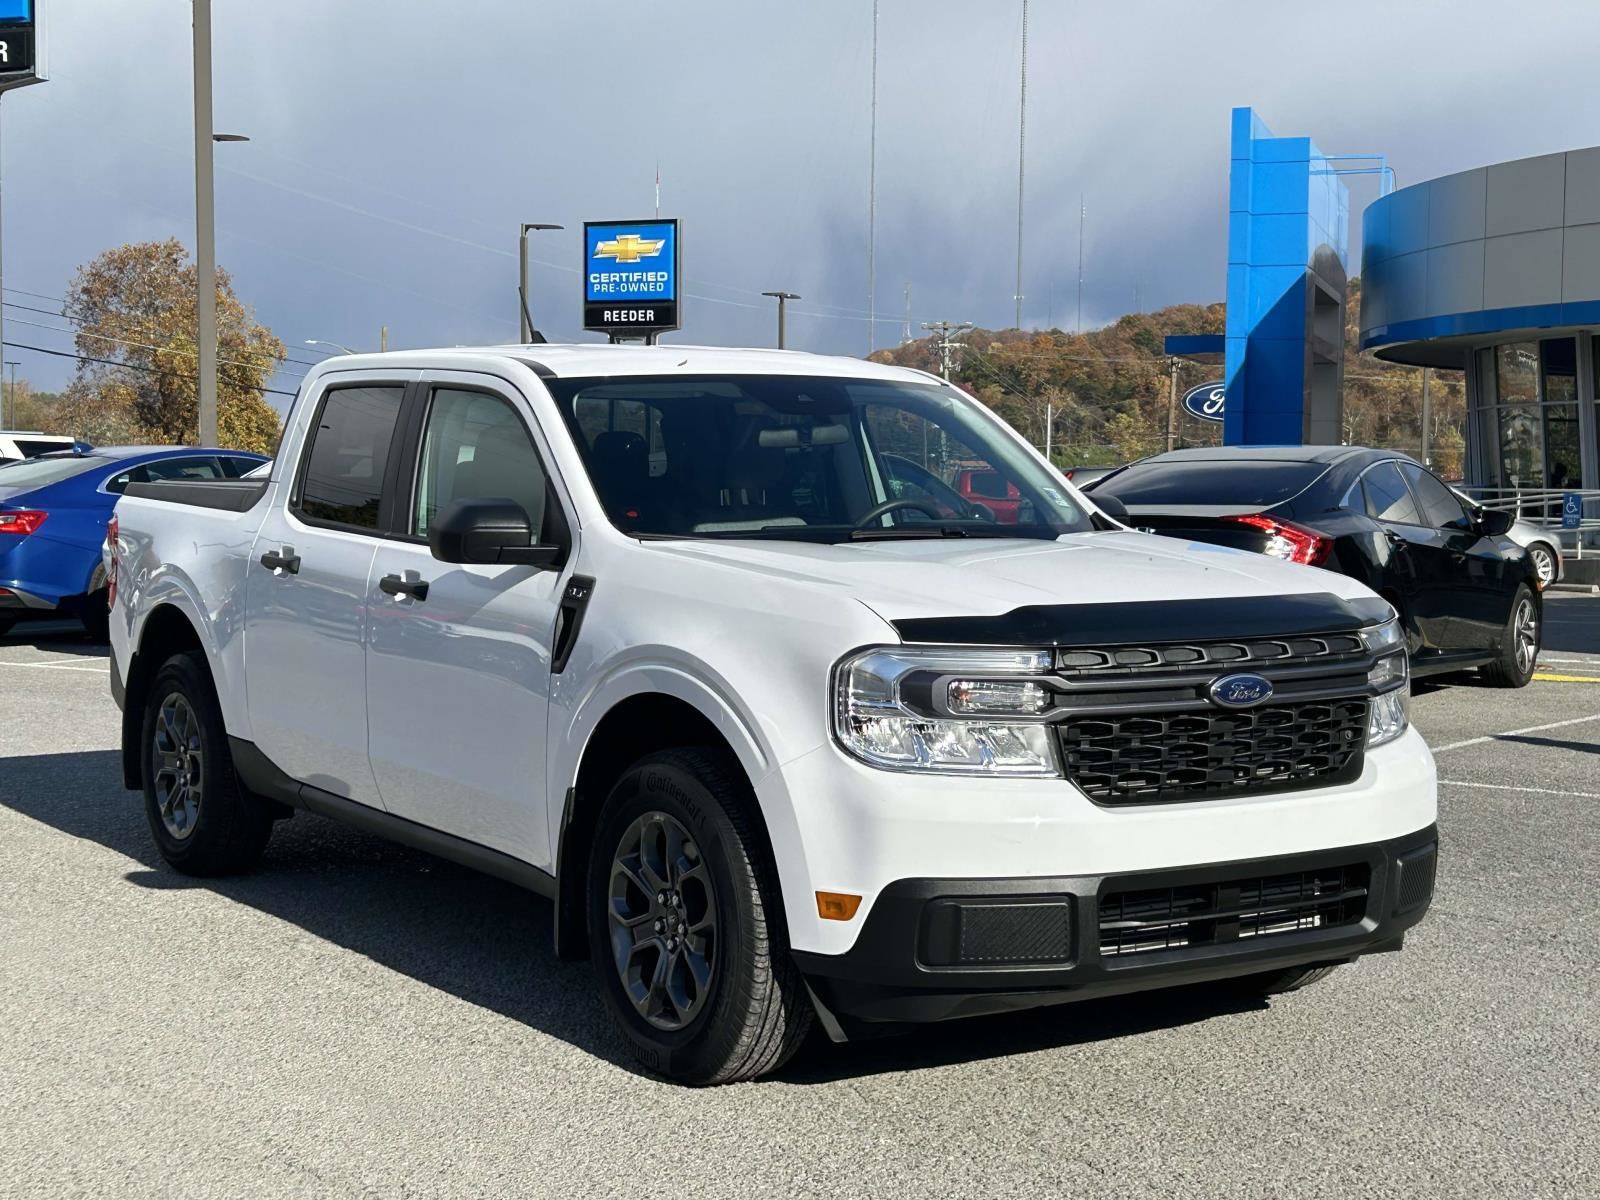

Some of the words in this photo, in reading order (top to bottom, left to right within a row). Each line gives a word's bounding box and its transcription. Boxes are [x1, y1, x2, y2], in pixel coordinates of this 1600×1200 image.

[590, 271, 668, 283] CERTIFIED
[593, 282, 664, 293] PRE-OWNED
[604, 309, 655, 322] REEDER
[1228, 681, 1261, 700] Ford
[646, 772, 700, 823] Continental
